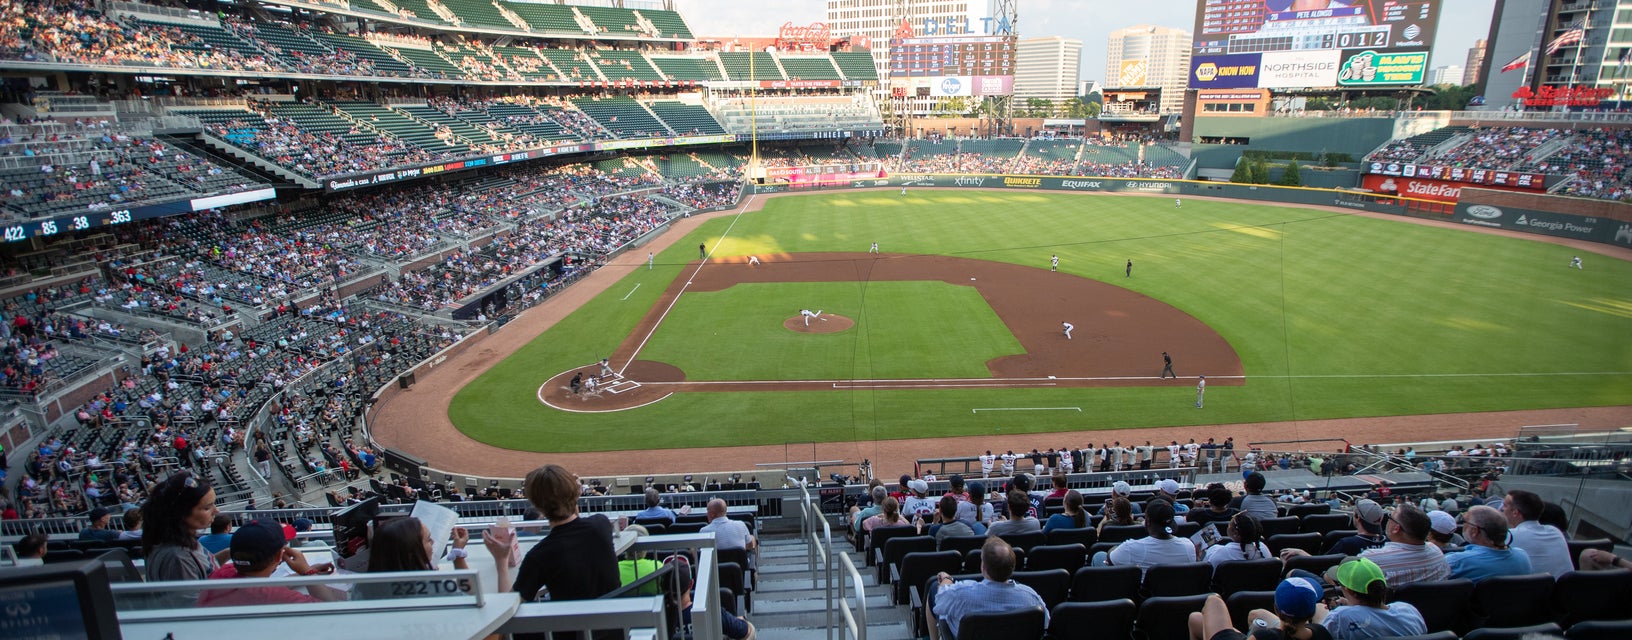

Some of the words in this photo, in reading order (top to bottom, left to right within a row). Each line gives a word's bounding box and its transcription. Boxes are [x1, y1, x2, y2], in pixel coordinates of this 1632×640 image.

[1296, 11, 1310, 19] PETE
[1310, 9, 1333, 18] ALONSO
[924, 17, 1012, 35] DELTA
[1379, 55, 1424, 65] MAVIS
[1200, 67, 1214, 76] NAPA
[1218, 66, 1239, 76] KNOW
[1239, 65, 1256, 76] HOW
[1264, 62, 1335, 72] NORTHSIDE
[1419, 168, 1430, 176] NL
[954, 176, 985, 187] xfinity
[1004, 177, 1041, 185] QUIKRETE
[1062, 180, 1102, 189] EQUIFAX
[1407, 180, 1461, 198] StateFar
[4, 225, 26, 242] 422
[41, 220, 58, 236] 85
[73, 216, 89, 230] 38
[110, 209, 131, 225] .363
[1529, 218, 1563, 230] Georgia
[1564, 222, 1593, 233] Power
